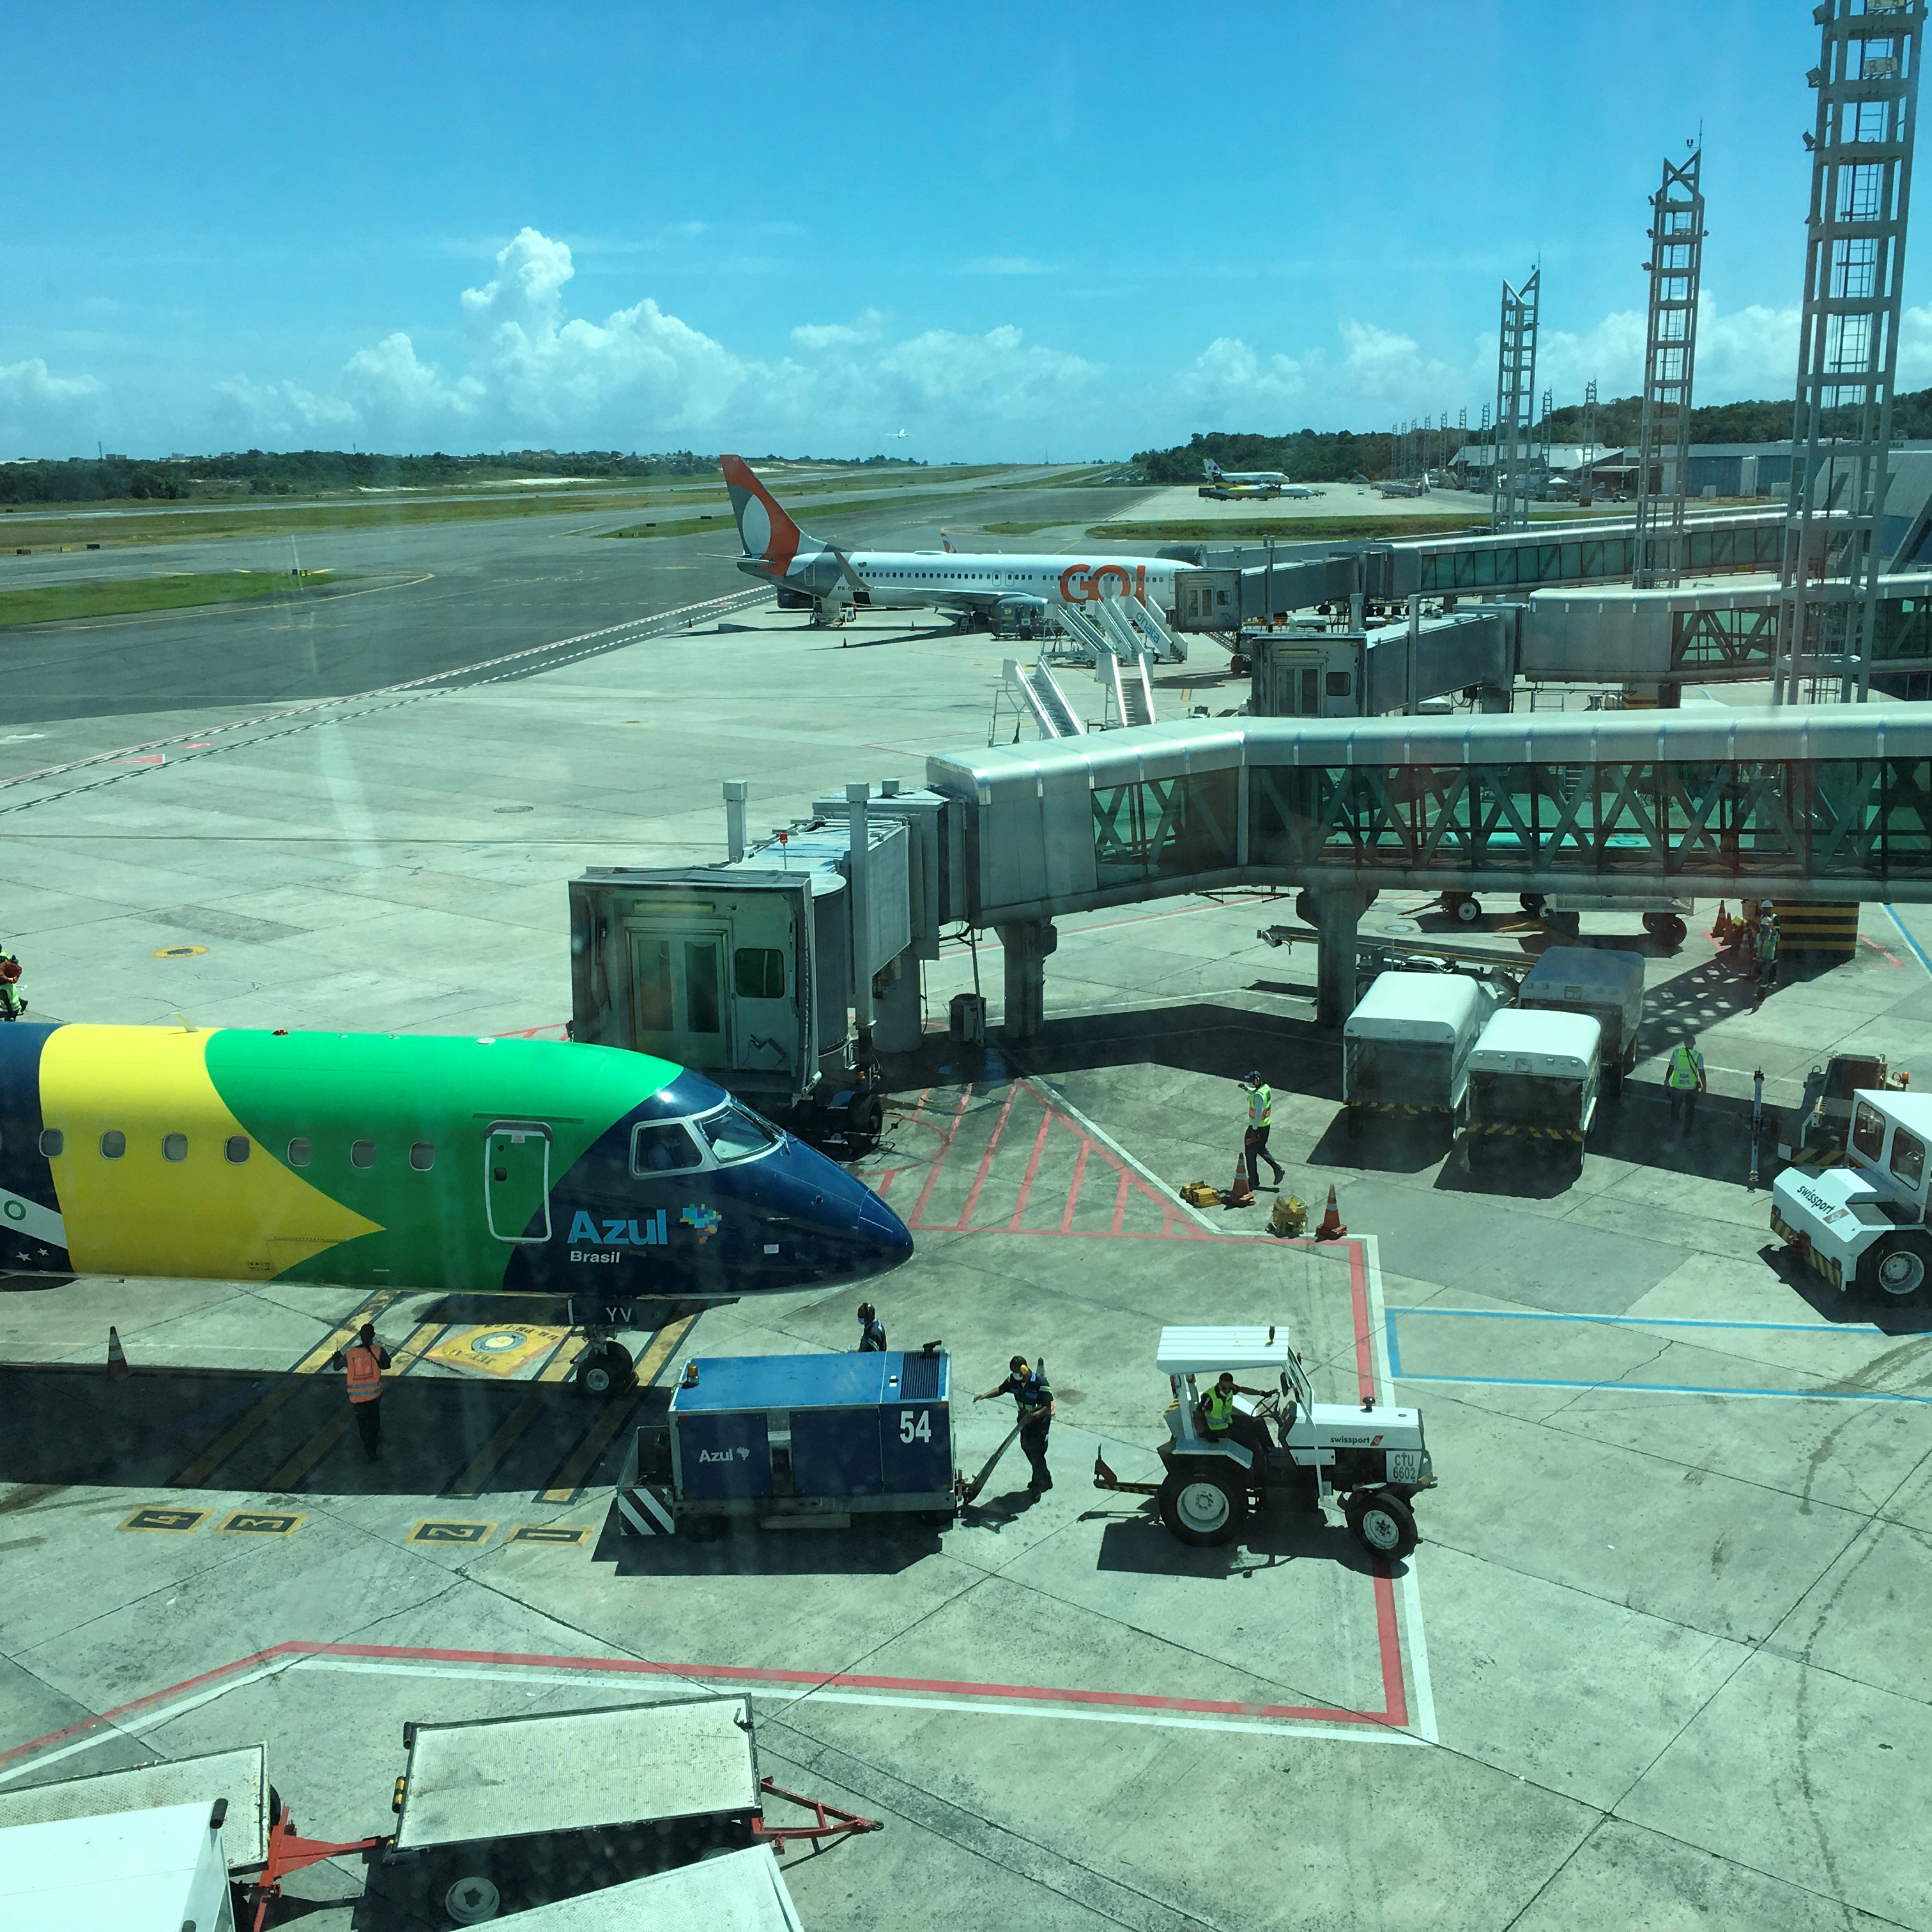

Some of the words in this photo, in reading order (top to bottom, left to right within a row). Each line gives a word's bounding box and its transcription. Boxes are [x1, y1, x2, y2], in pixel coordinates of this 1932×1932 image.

[1135, 611, 1160, 643] dnata
[1797, 1184, 1836, 1215] swissport
[567, 1209, 668, 1245] Azul
[570, 1250, 621, 1263] Brasil
[605, 1307, 632, 1322] YV
[899, 1409, 932, 1444] 54
[1330, 1435, 1370, 1445] swissport
[698, 1448, 734, 1462] Azul
[1395, 1452, 1414, 1467] CTU
[1393, 1467, 1416, 1480] 6602
